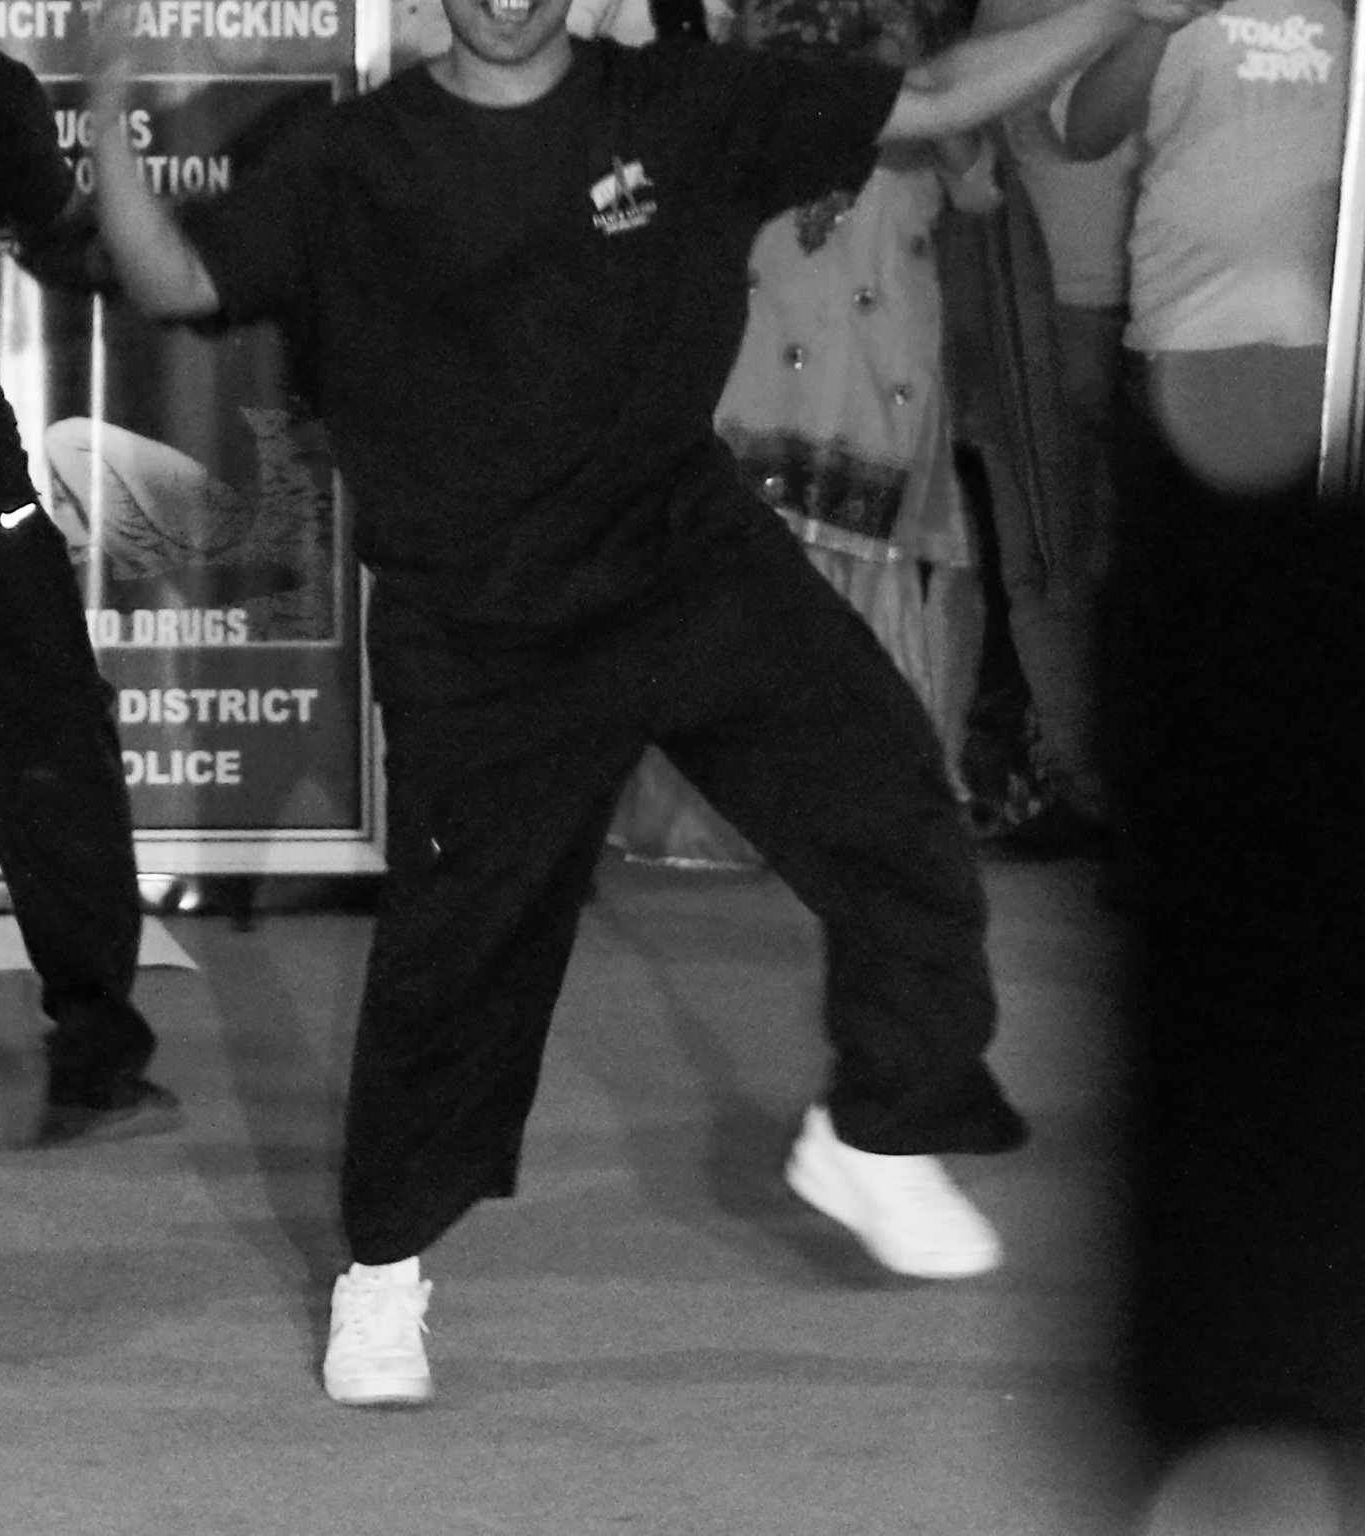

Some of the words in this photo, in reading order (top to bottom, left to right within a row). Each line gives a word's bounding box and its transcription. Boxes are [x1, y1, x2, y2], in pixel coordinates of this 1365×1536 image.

[80, 0, 340, 39] TAFFICKING
[132, 608, 248, 646] DRUGS
[119, 688, 319, 723] DISTRICT
[122, 749, 243, 785] OLICE
